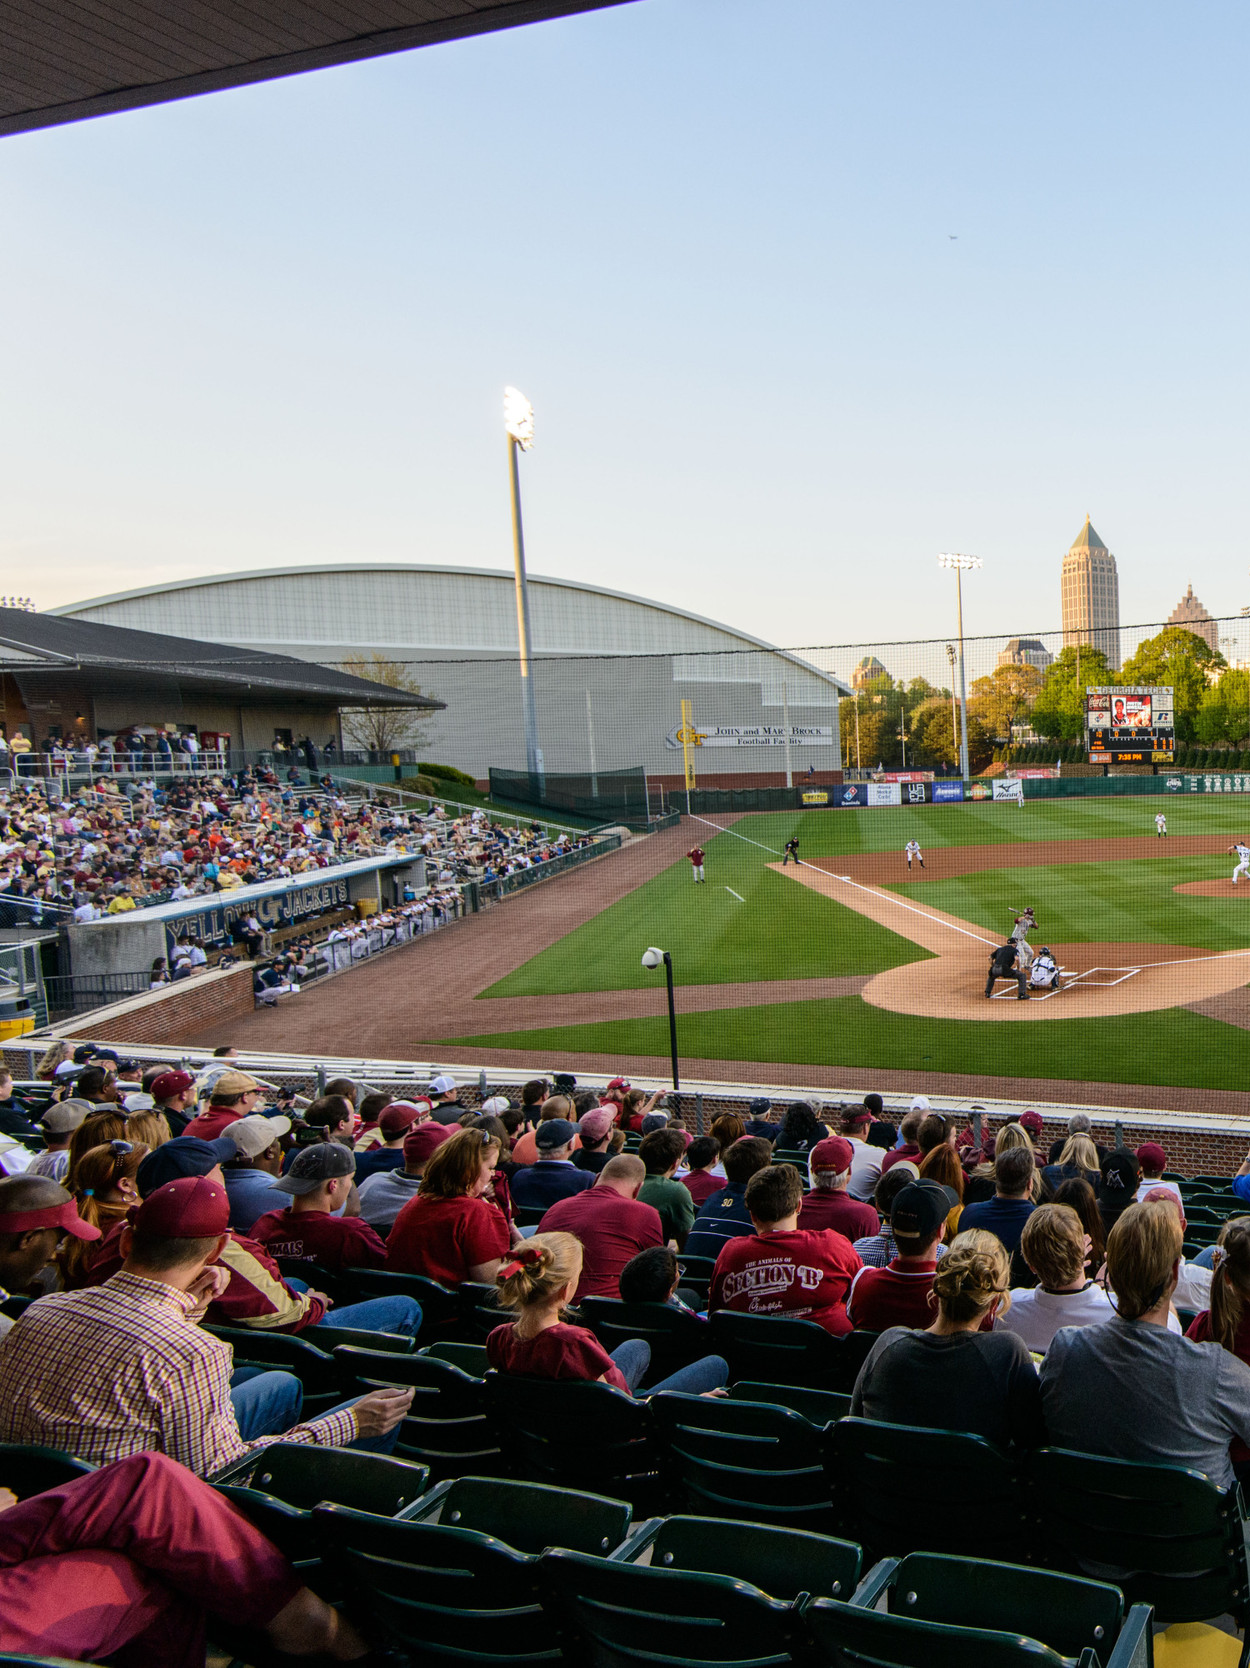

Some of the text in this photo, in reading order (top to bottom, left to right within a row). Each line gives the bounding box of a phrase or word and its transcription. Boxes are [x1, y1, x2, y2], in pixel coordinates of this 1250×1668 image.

[1101, 686, 1140, 694] GEORGIA
[1142, 686, 1163, 694] TECH
[715, 727, 741, 735] JOHN
[762, 727, 787, 735] MAR
[792, 727, 822, 735] BROCK
[773, 738, 803, 746] Faclity
[1117, 753, 1131, 761] 7:35
[283, 877, 348, 919] JACKETS
[797, 1139, 808, 1151] 2
[721, 1198, 734, 1207] 30
[745, 1261, 757, 1269] THE
[758, 1257, 783, 1265] ANIMALS
[722, 1264, 796, 1303] SECTION
